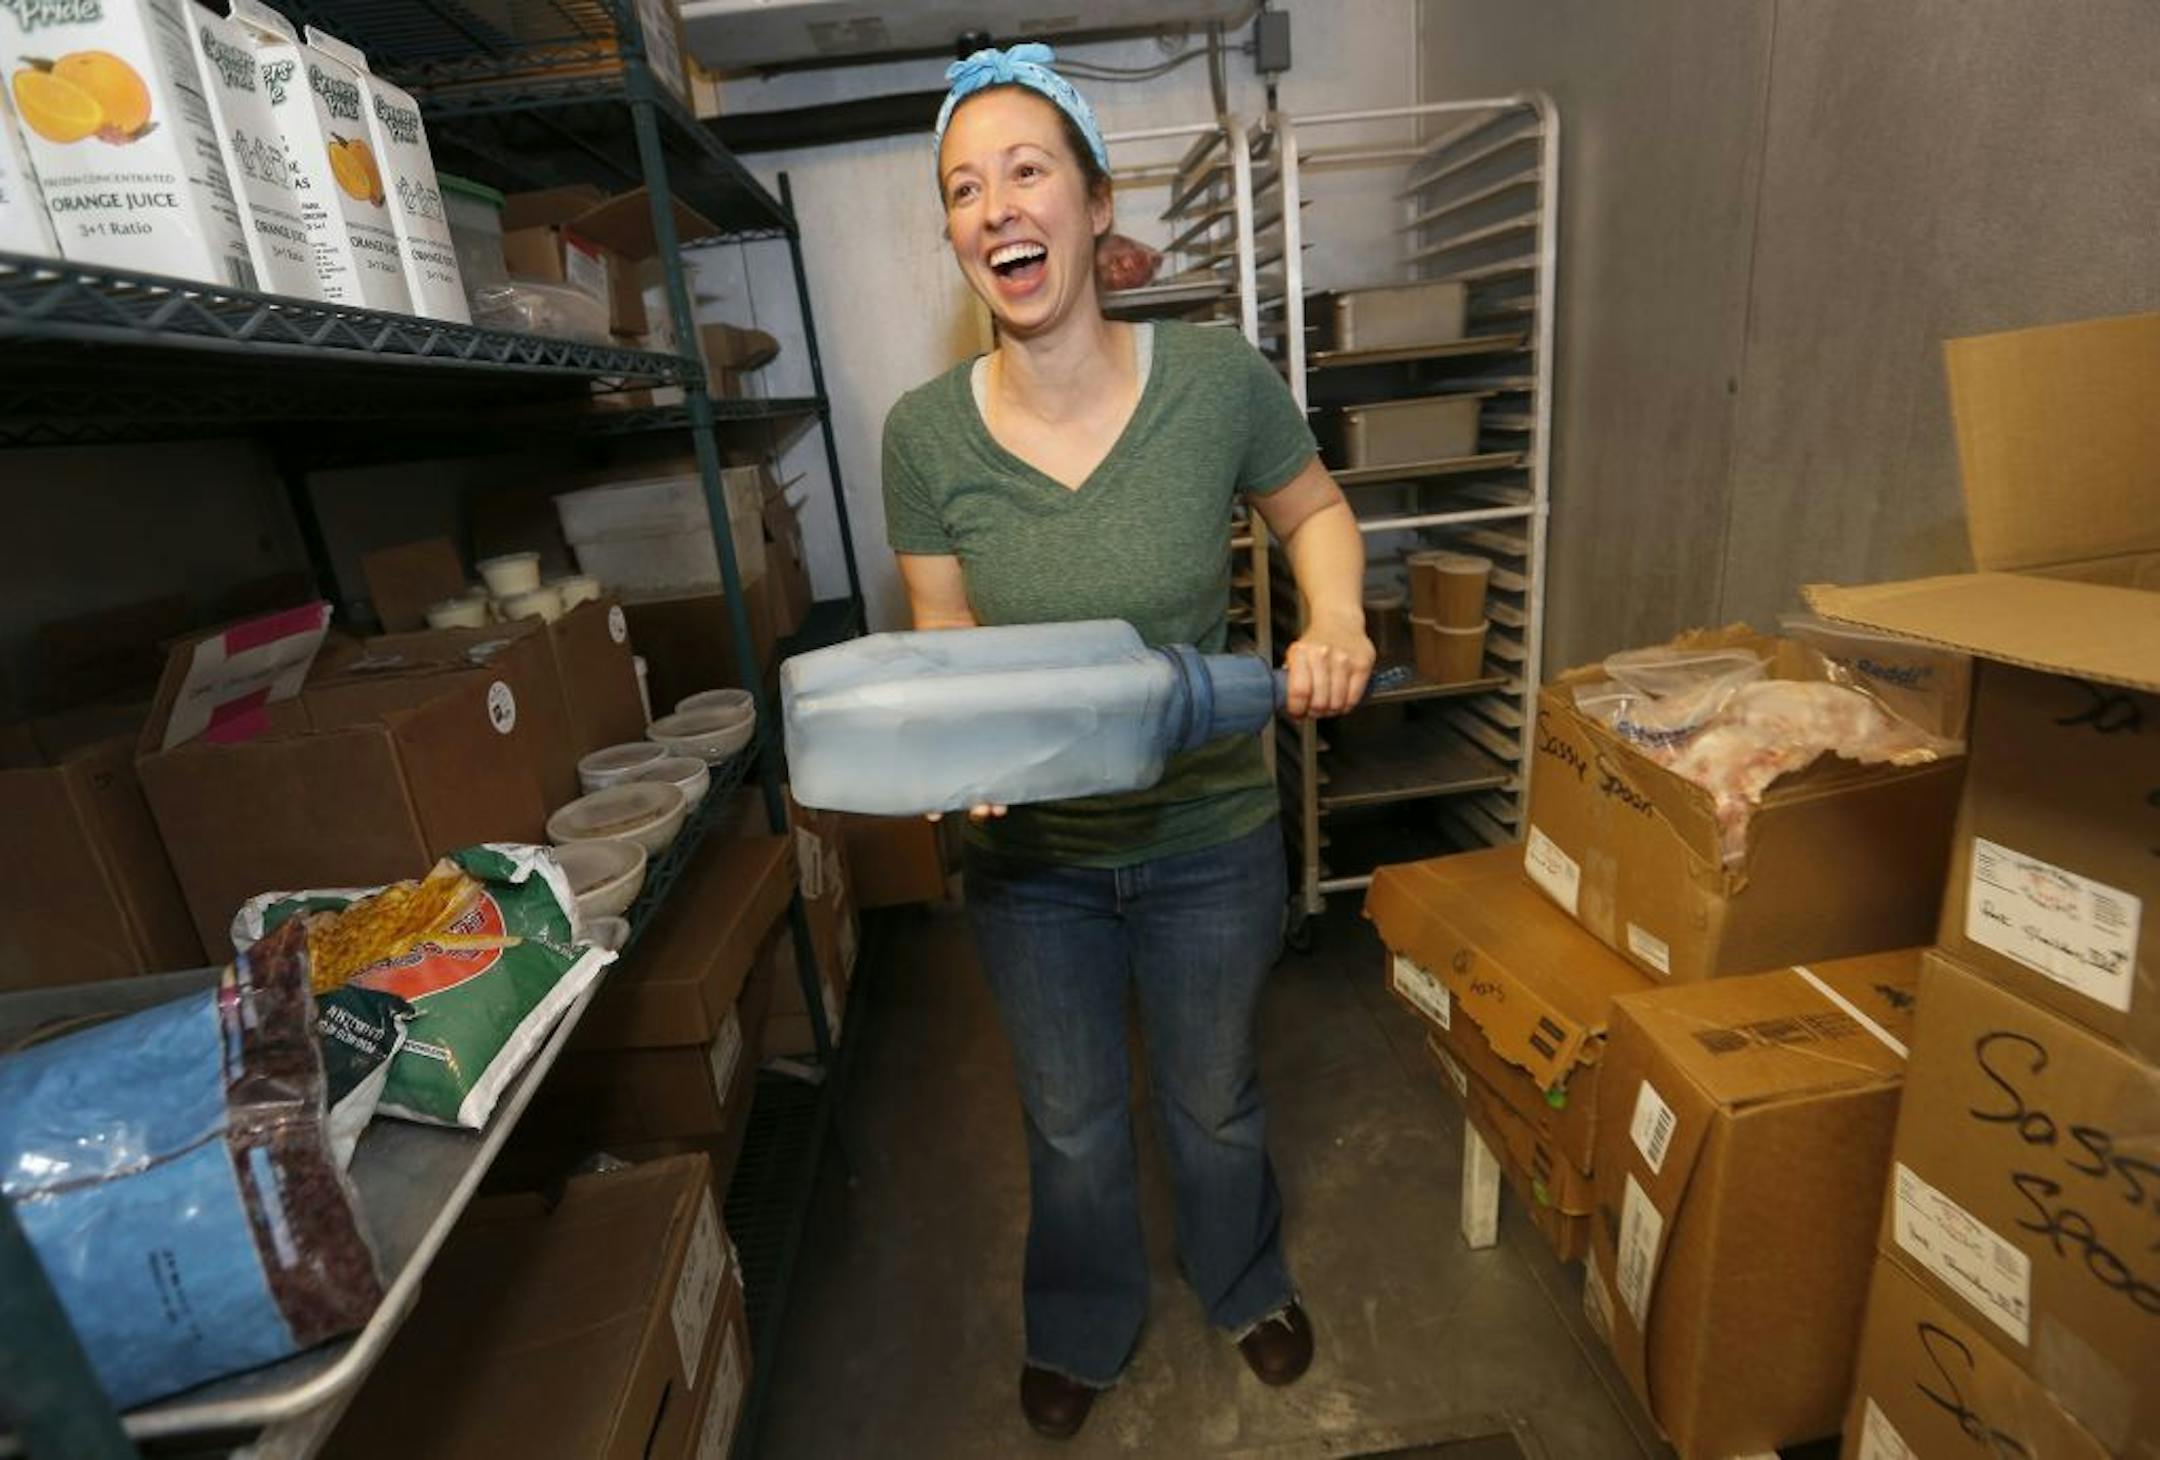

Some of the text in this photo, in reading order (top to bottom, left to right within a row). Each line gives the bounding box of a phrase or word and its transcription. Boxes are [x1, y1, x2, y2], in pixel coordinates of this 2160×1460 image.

[15, 0, 104, 32] Pride
[52, 192, 180, 212] ORANGE JUICE
[110, 221, 153, 235] Ratio
[1969, 1030, 2160, 1206] Sass
[2011, 1172, 2160, 1314] Spoo
